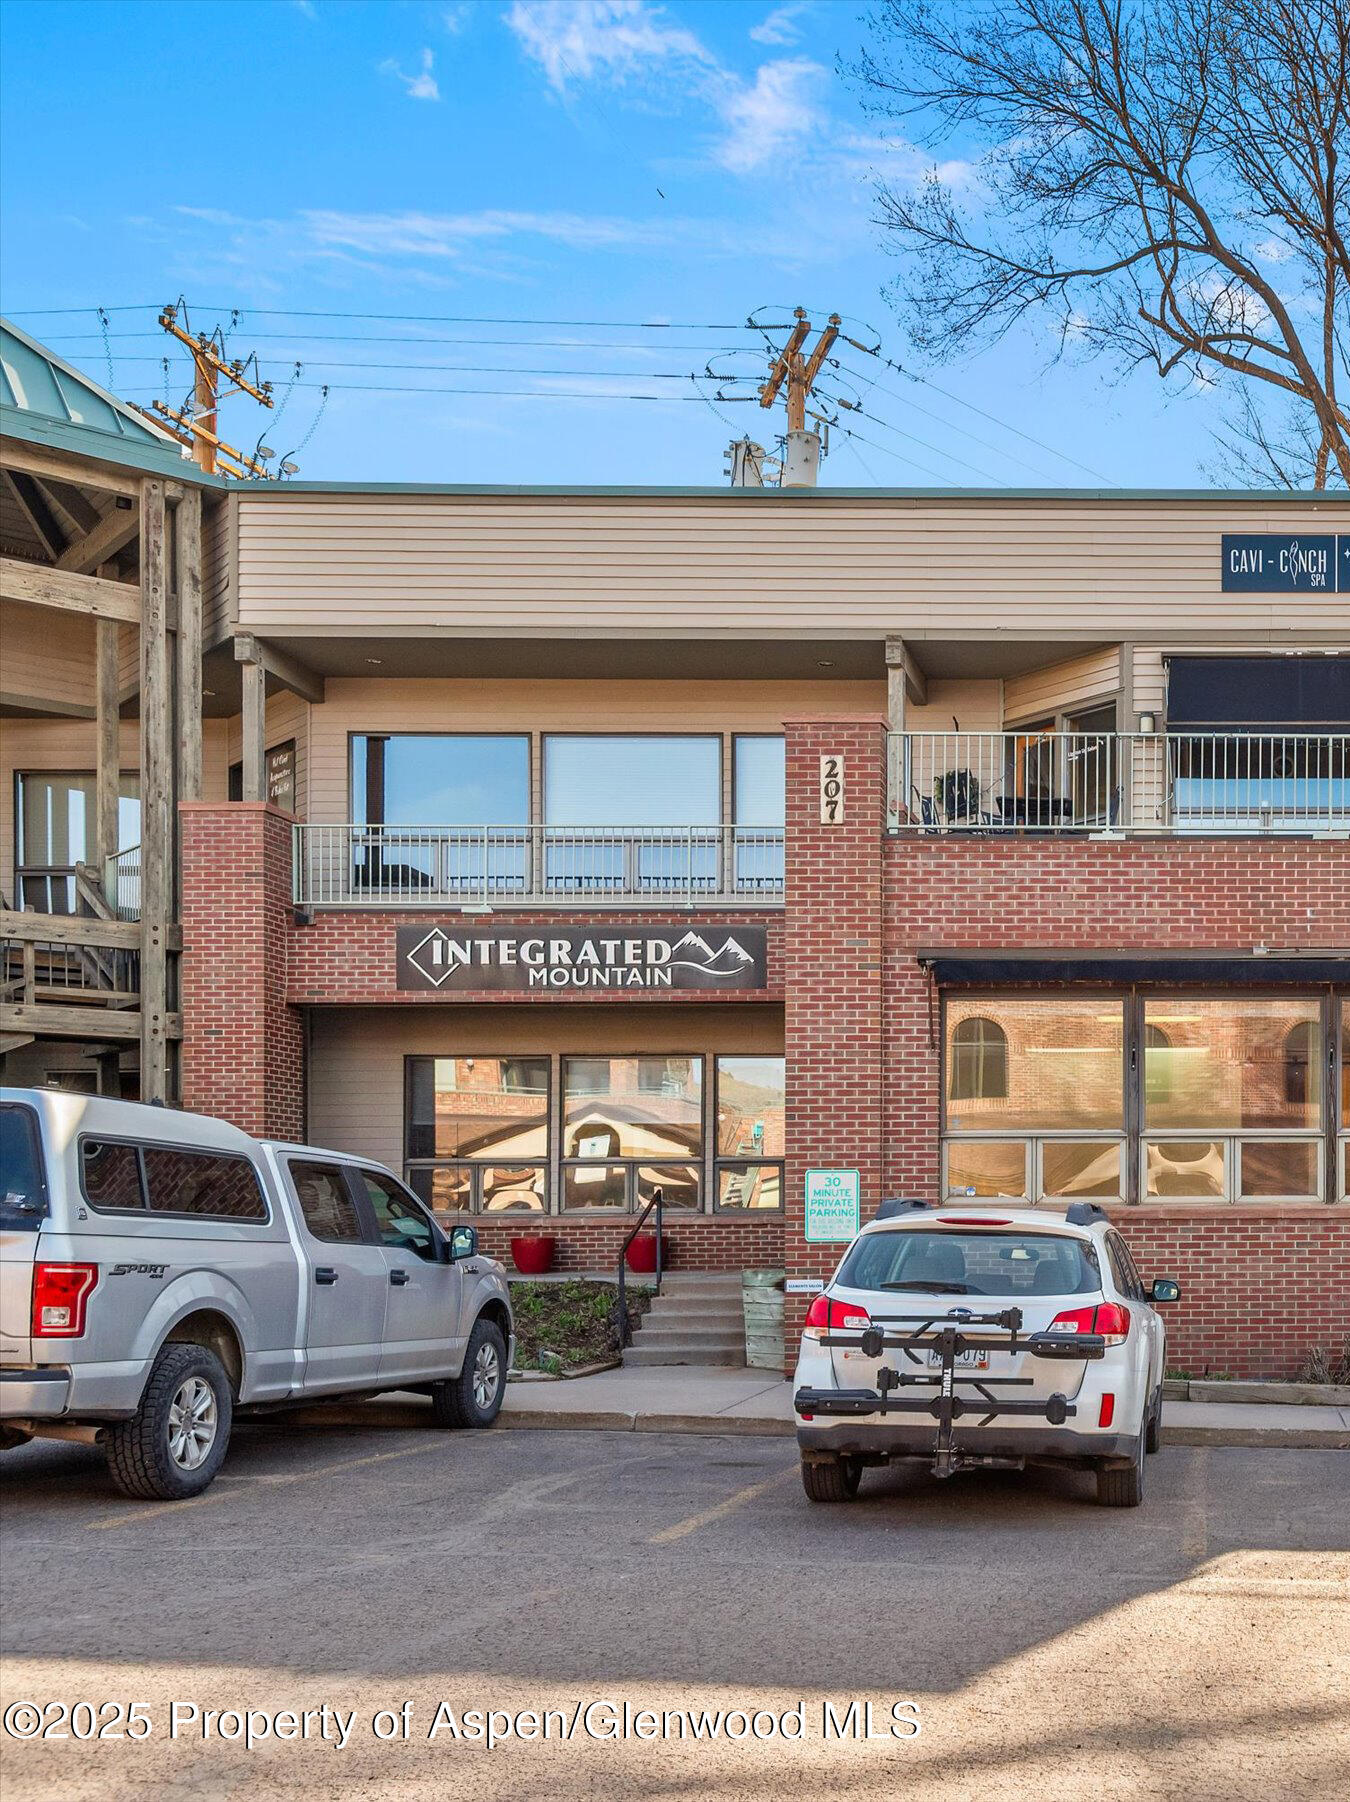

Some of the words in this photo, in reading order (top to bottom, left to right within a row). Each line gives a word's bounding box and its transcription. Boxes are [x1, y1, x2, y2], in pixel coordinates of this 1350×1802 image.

[1230, 549, 1263, 573] CAVI
[1310, 573, 1326, 587] SPA
[824, 759, 841, 820] 207
[432, 939, 673, 966] INTEGRATED
[529, 966, 673, 987] MOUNTAIN
[824, 1176, 841, 1187] 30
[813, 1188, 851, 1197] MINUTE
[810, 1199, 854, 1207] PRIVATE
[809, 1208, 856, 1217] PARKING
[109, 1264, 170, 1275] SPORT
[942, 1368, 952, 1397] THULE
